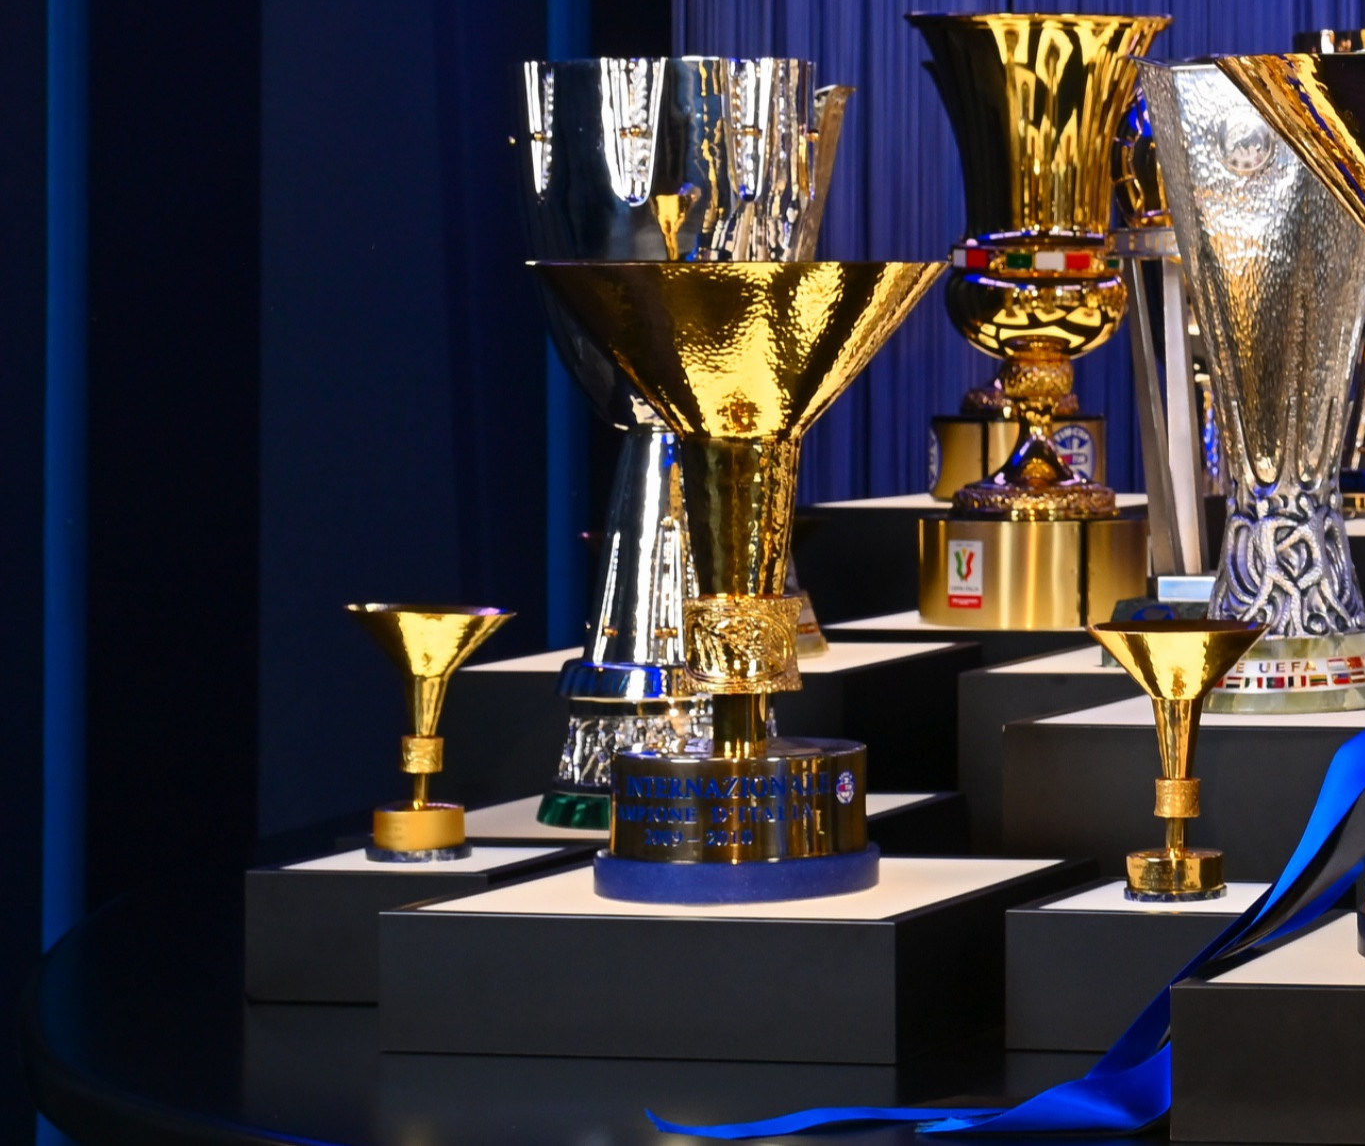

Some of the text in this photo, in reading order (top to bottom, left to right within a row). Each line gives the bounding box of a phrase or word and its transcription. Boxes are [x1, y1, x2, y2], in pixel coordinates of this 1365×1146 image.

[1258, 658, 1317, 674] UEFA
[625, 773, 831, 799] INTERNAZIONALE
[705, 828, 754, 847] 2010
